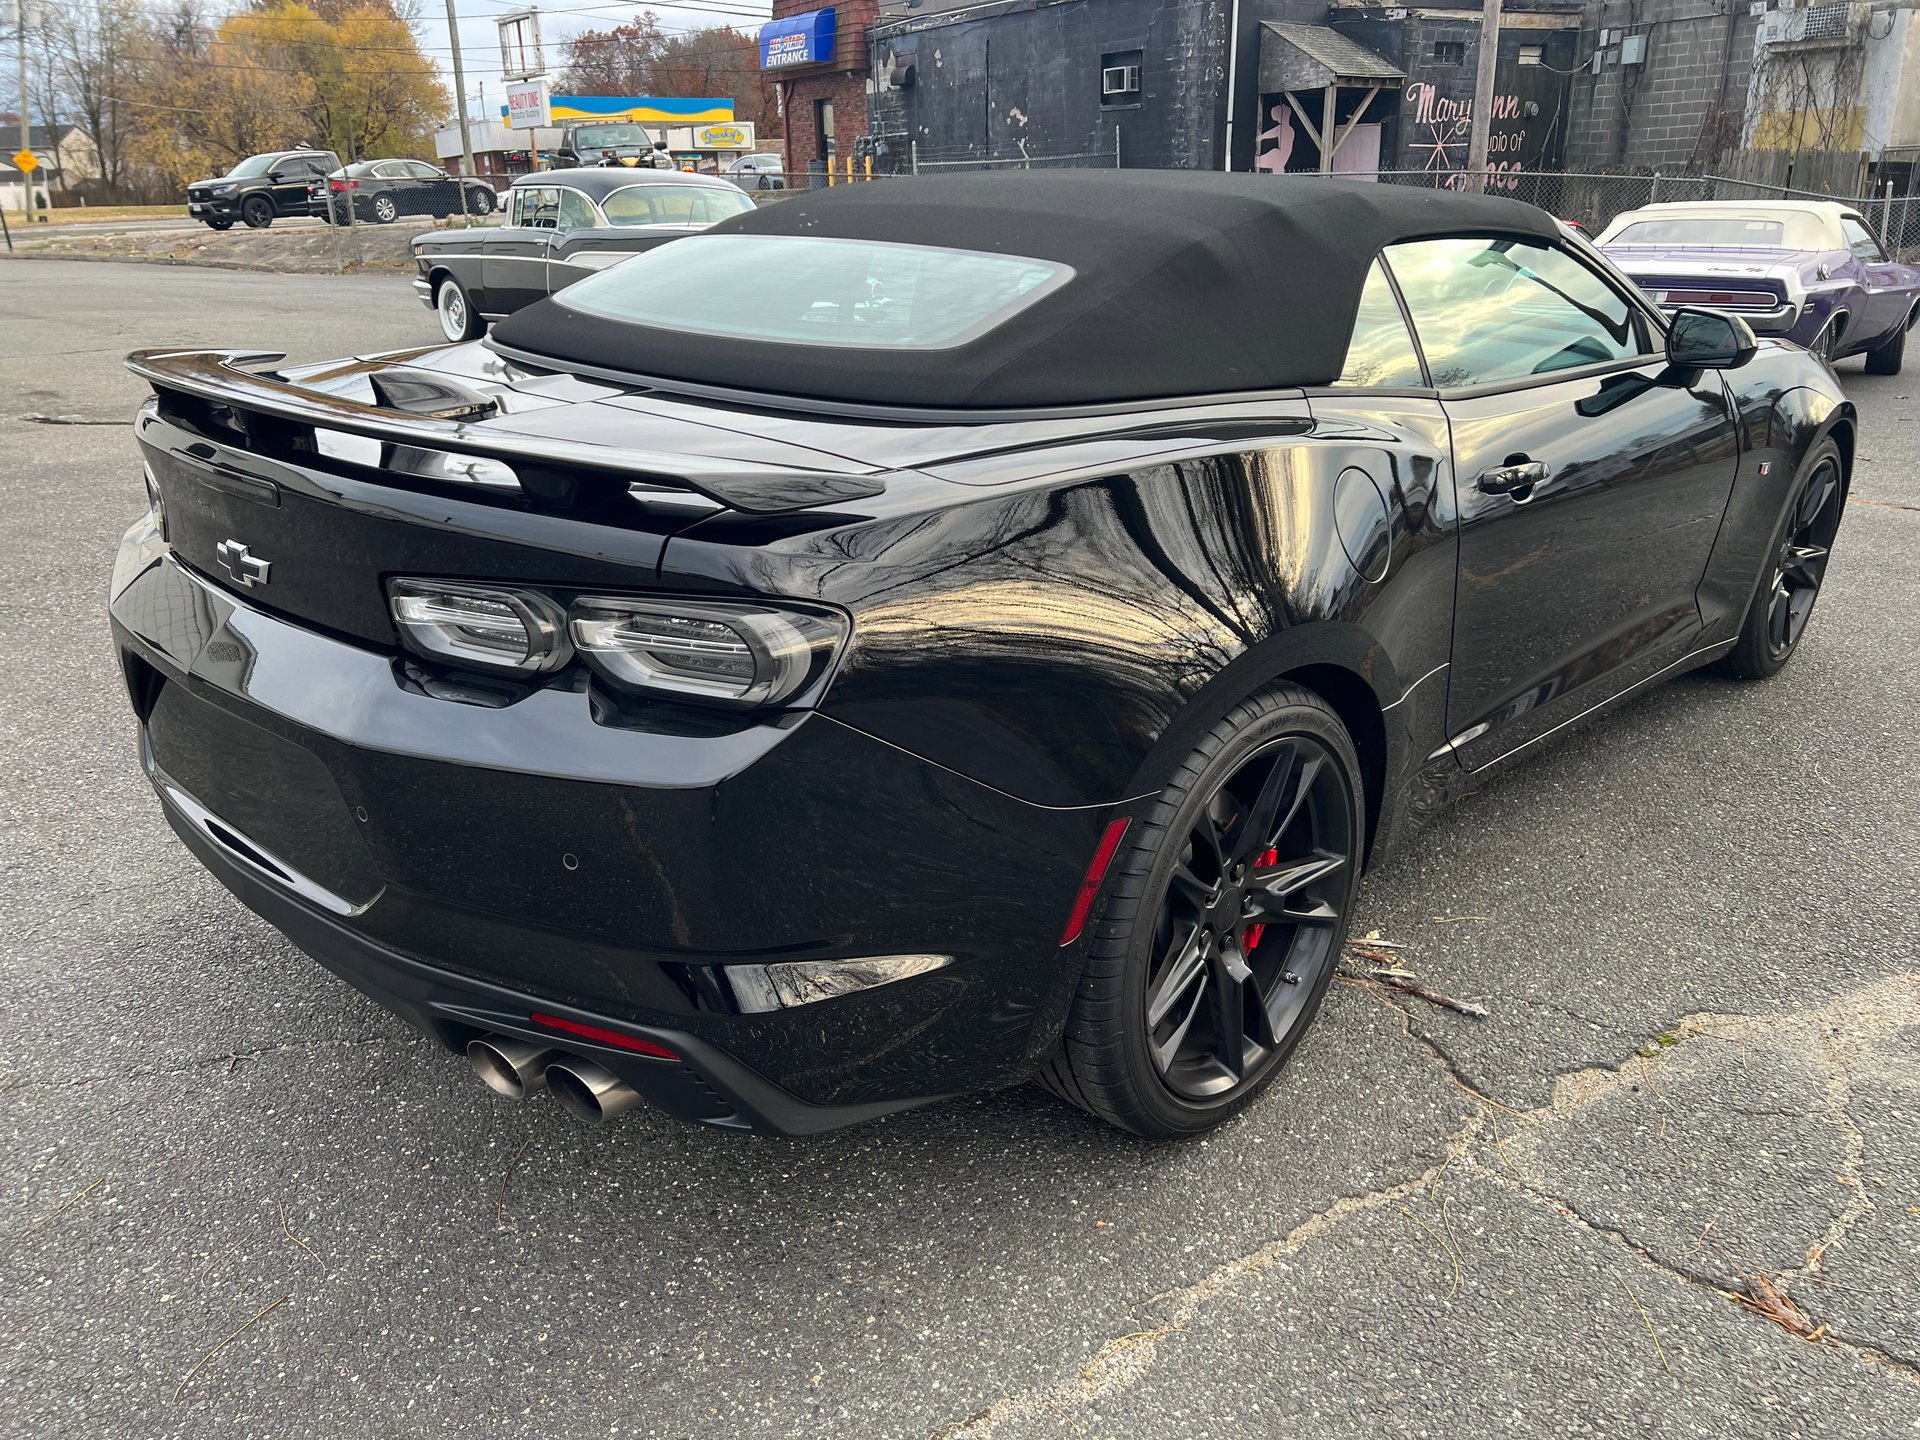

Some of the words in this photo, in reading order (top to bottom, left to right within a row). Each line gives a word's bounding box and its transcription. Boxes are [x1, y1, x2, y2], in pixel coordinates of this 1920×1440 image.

[766, 49, 809, 67] ENTRANCE
[509, 93, 528, 110] BEAUTY
[528, 91, 539, 108] ONE
[1406, 83, 1472, 135] Mary
[1492, 95, 1520, 119] nn
